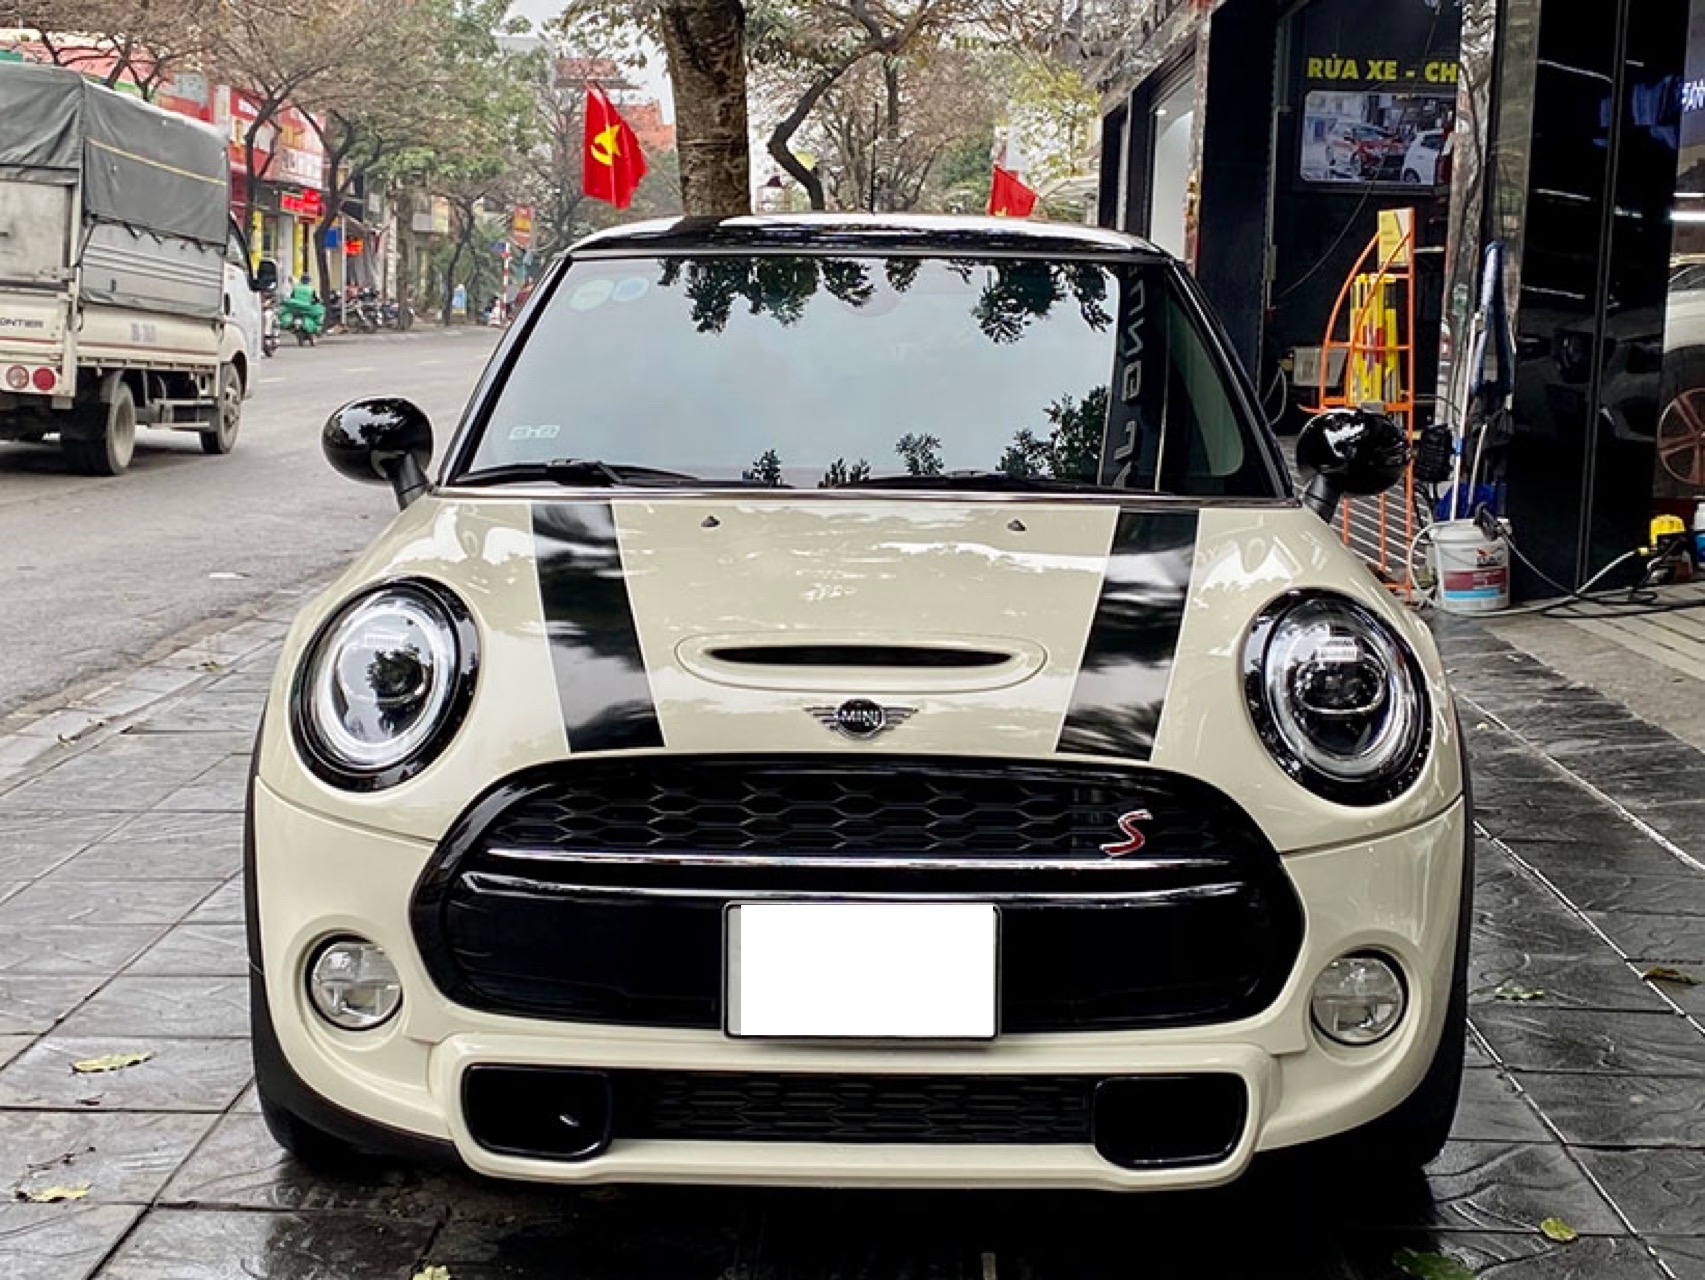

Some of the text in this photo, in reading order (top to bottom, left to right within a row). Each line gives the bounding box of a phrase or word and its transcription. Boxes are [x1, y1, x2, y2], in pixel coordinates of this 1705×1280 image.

[1365, 60, 1398, 81] XE
[1424, 61, 1458, 83] CH
[841, 710, 879, 727] MINI
[1099, 808, 1154, 858] S
